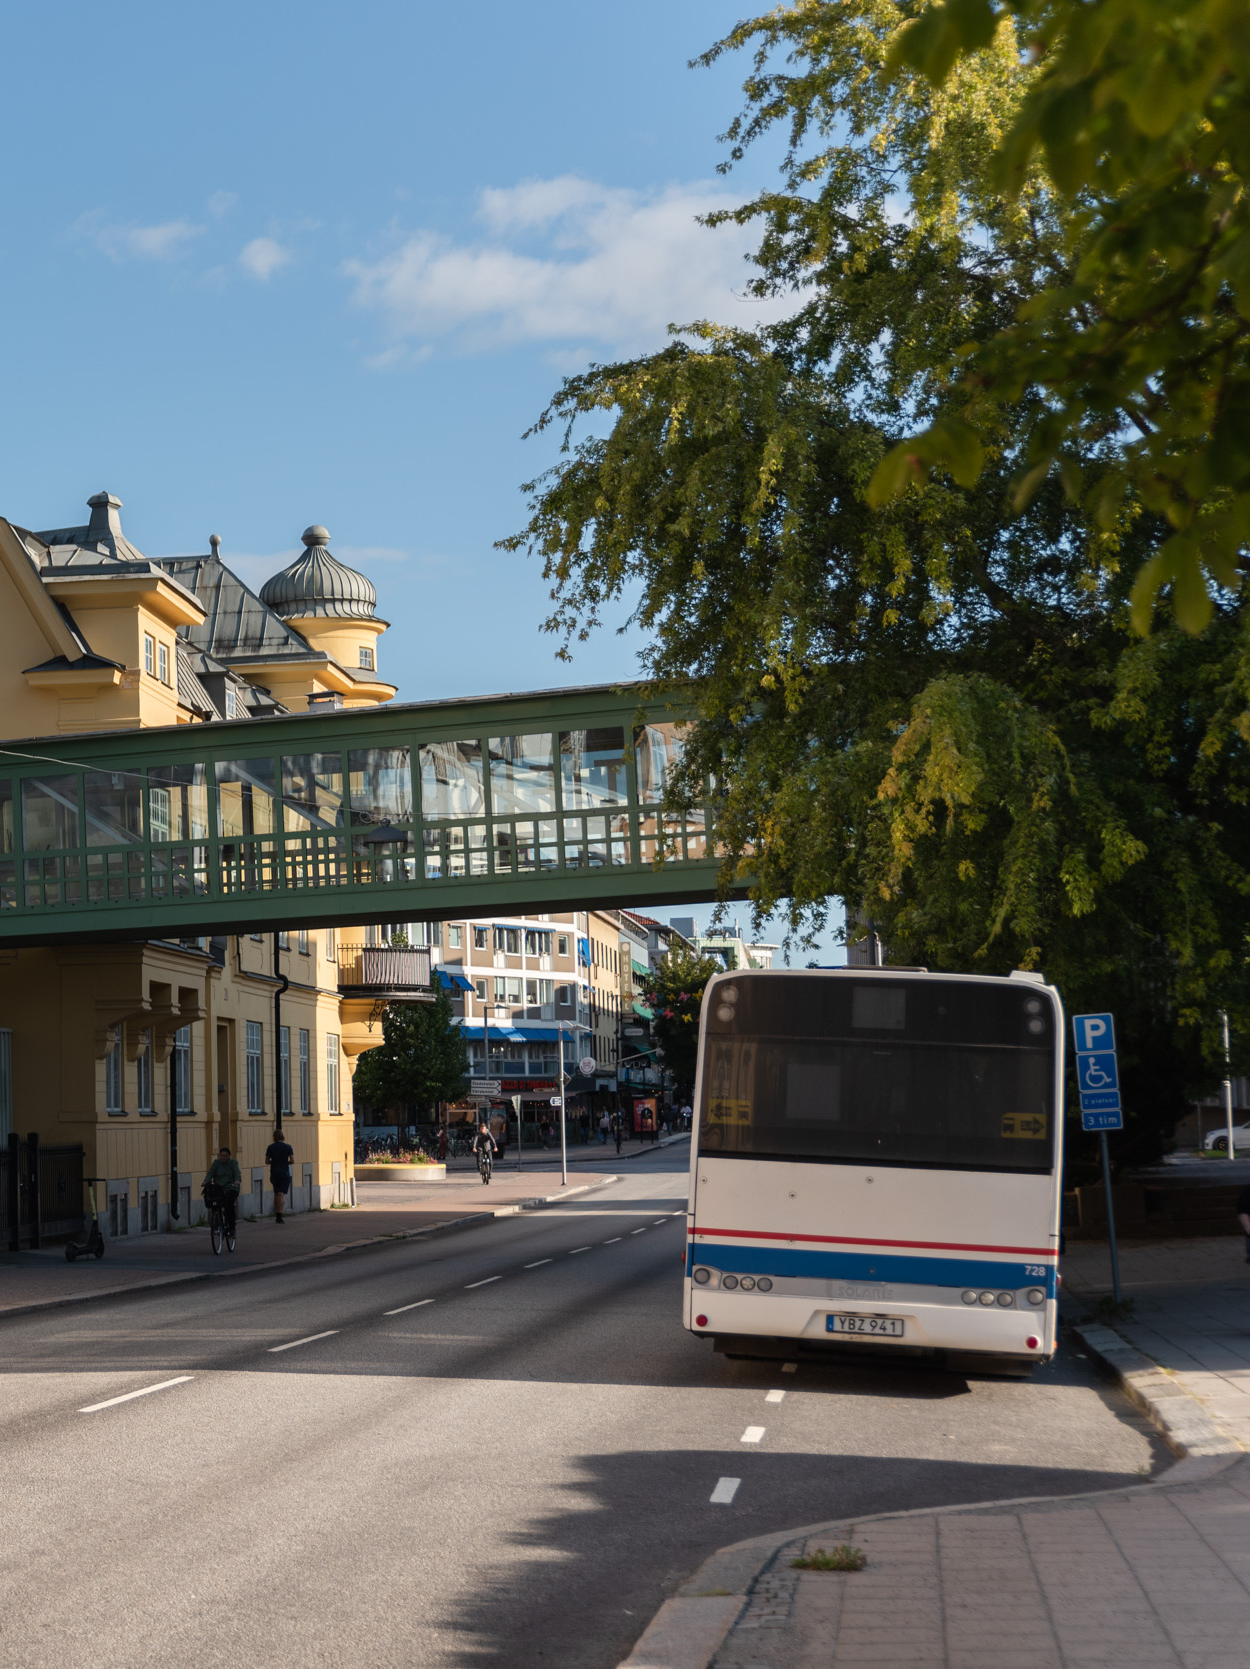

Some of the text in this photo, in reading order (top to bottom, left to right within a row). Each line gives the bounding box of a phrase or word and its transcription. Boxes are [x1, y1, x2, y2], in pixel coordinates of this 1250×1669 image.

[1084, 1018, 1106, 1048] P
[1088, 1115, 1118, 1126] 3 tim
[1024, 1265, 1046, 1277] 728
[838, 1286, 894, 1299] SOLARIS
[839, 1317, 896, 1333] YBZ 941
